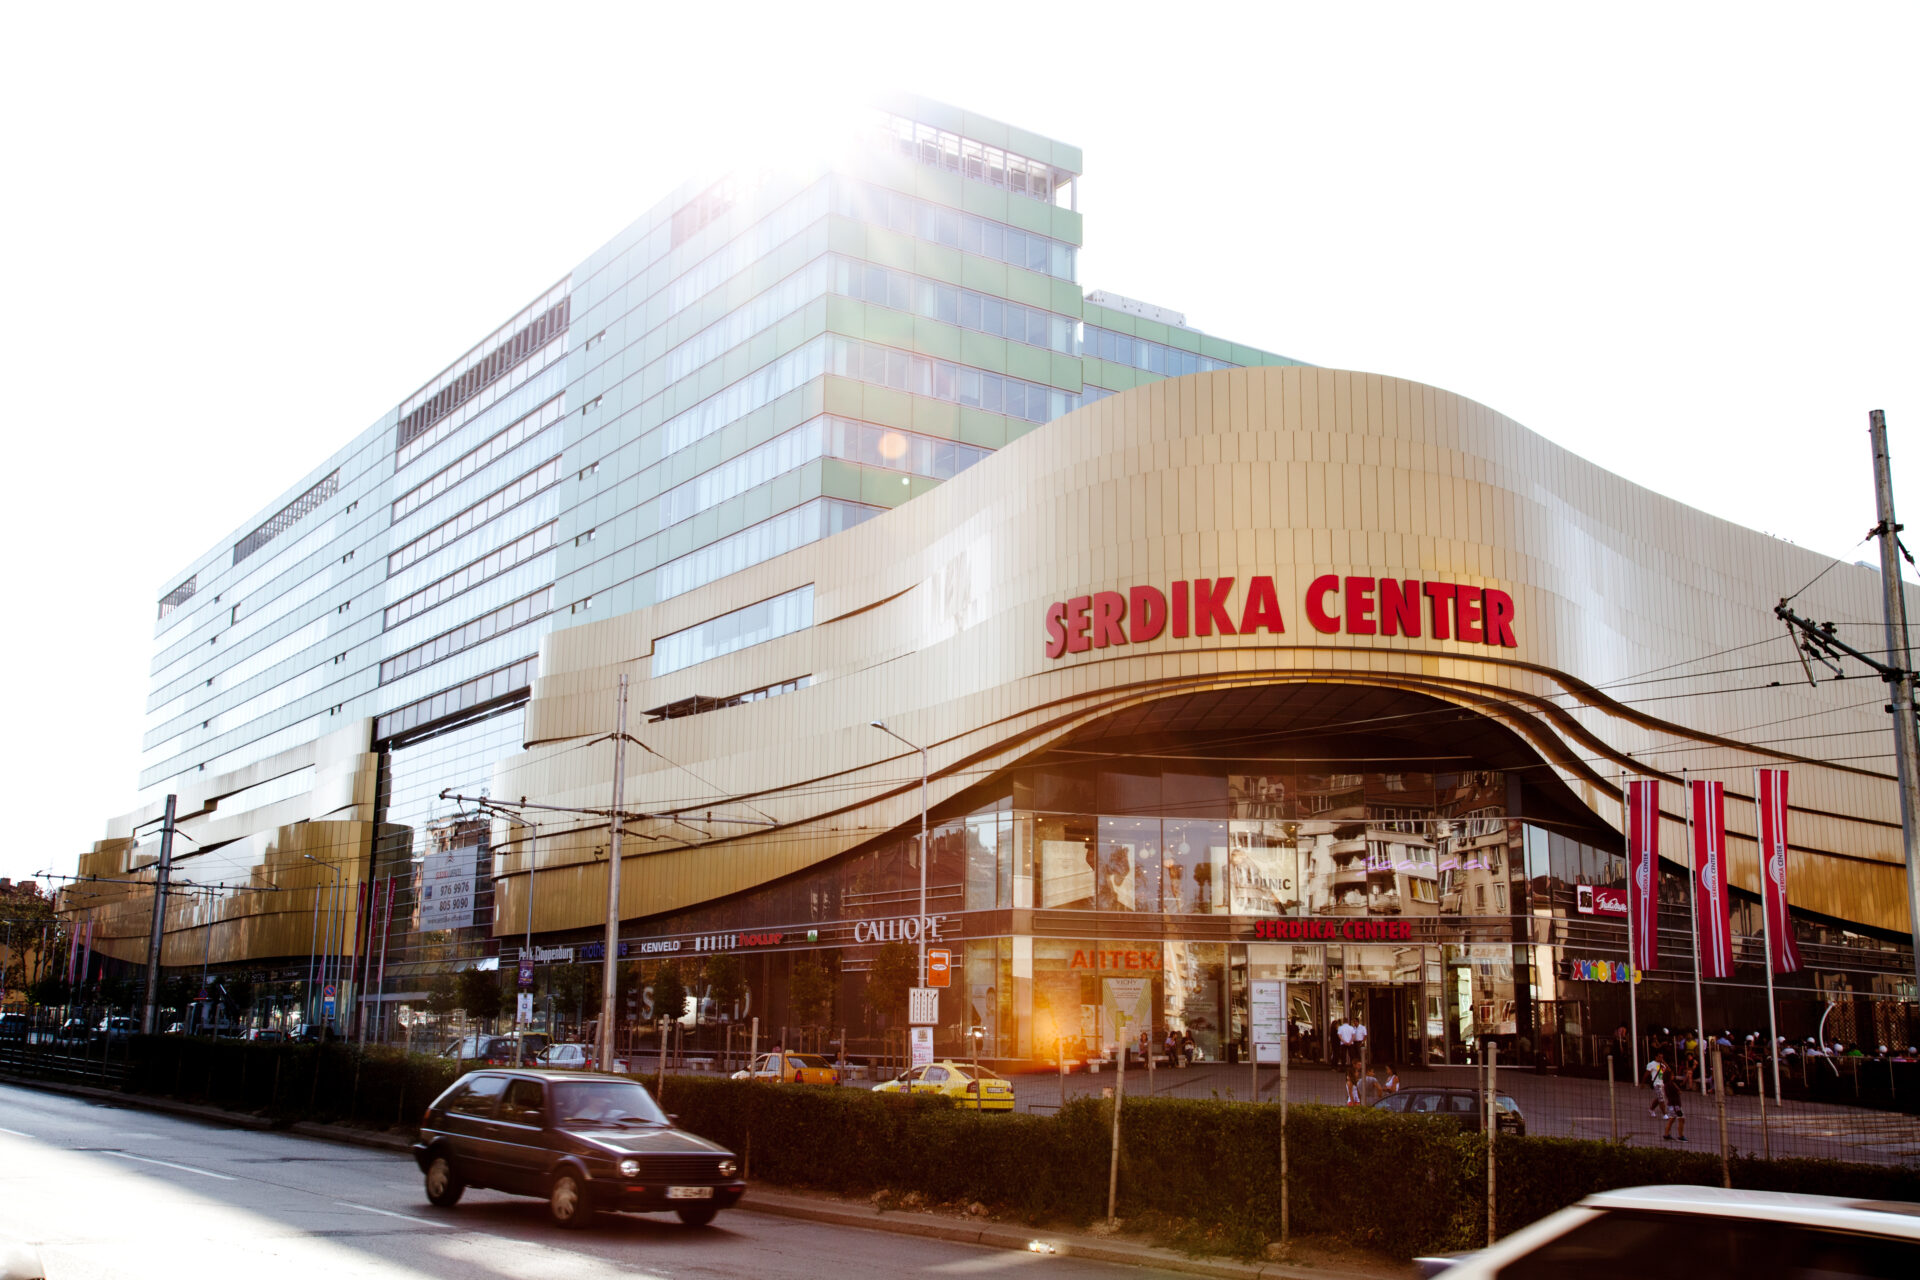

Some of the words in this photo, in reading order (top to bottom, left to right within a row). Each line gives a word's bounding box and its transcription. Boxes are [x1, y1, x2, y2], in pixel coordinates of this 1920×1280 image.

[1045, 575, 1285, 659] SERDIKA
[1305, 574, 1519, 648] CENTER
[1776, 845, 1784, 867] CENTER
[440, 884, 452, 896] 976
[453, 881, 470, 894] 9976
[439, 900, 451, 911] 805
[452, 897, 469, 910] 9090
[854, 915, 947, 943] CALLIOPE
[1255, 920, 1337, 939] SERDIKA
[1343, 921, 1413, 940] CENTER
[640, 940, 681, 953] KENVELO
[1070, 949, 1162, 970] АПТЕК
